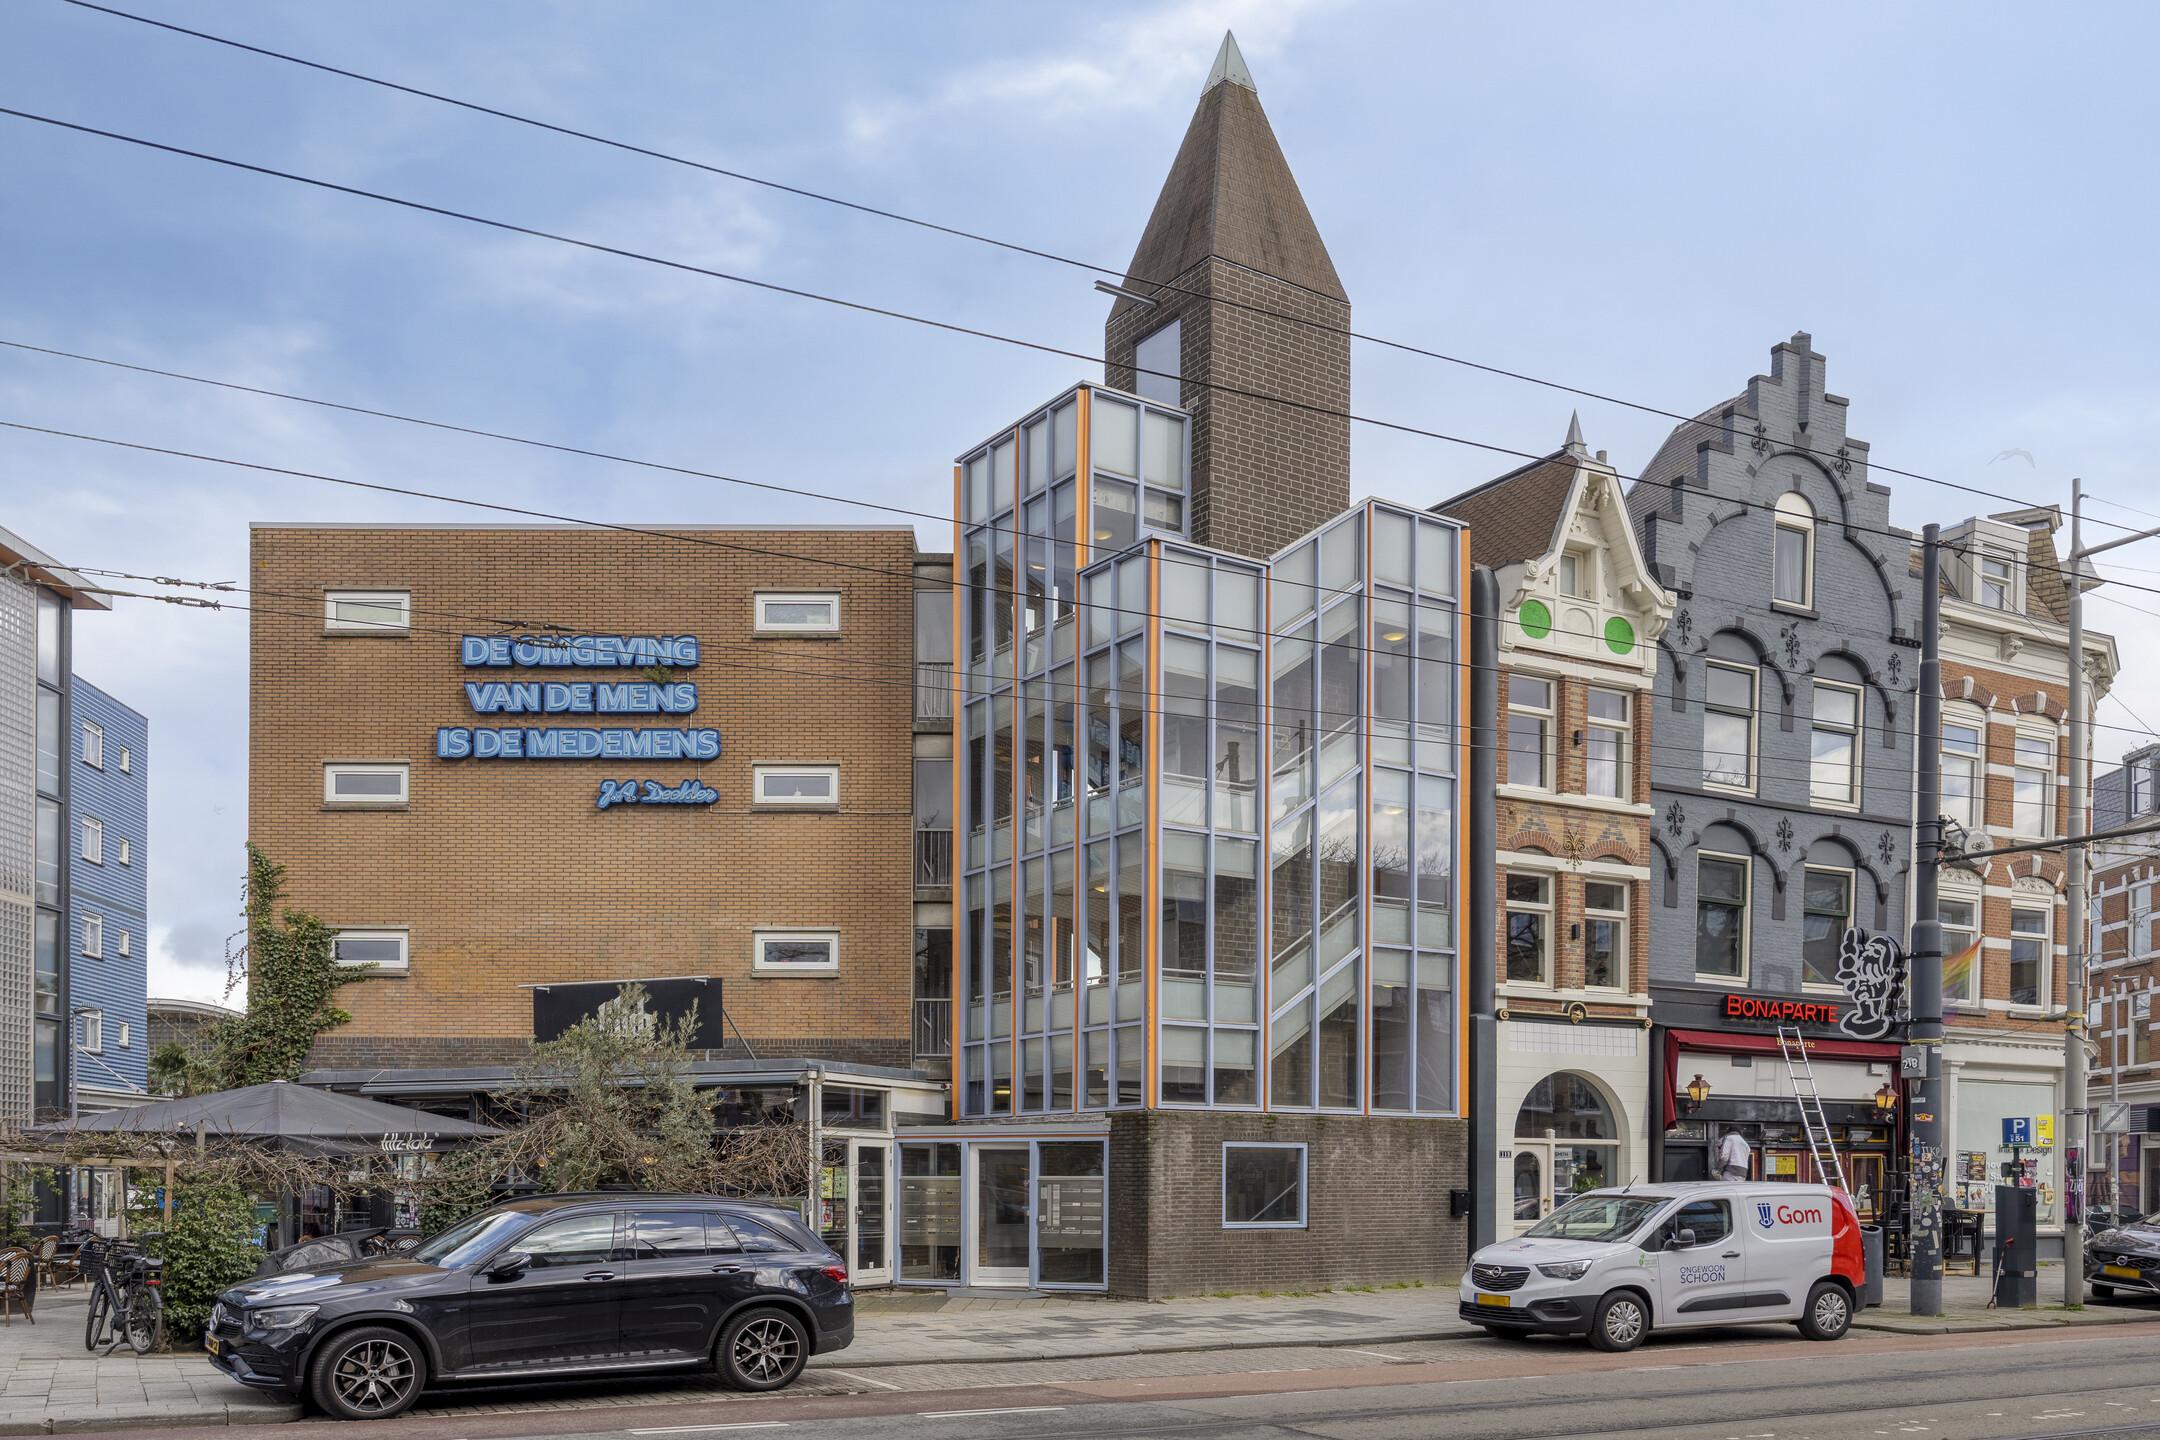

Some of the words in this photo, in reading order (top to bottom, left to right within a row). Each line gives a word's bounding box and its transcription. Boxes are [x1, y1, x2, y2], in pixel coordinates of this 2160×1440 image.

[462, 635, 511, 667] DE
[512, 634, 699, 667] OMGEVING
[464, 682, 541, 714] VAN
[543, 682, 594, 714] DE
[596, 682, 698, 714] MENS
[437, 727, 471, 759] IS
[473, 727, 525, 759] DE
[526, 727, 721, 760] MEDEMENS
[641, 779, 720, 805] Deelder
[1727, 994, 1840, 1023] BONAPARTE
[2013, 1119, 2025, 1133] P
[1777, 1205, 1822, 1224] Gom
[1680, 1264, 1725, 1274] ONGEWOON
[1680, 1272, 1725, 1284] SCHOON
